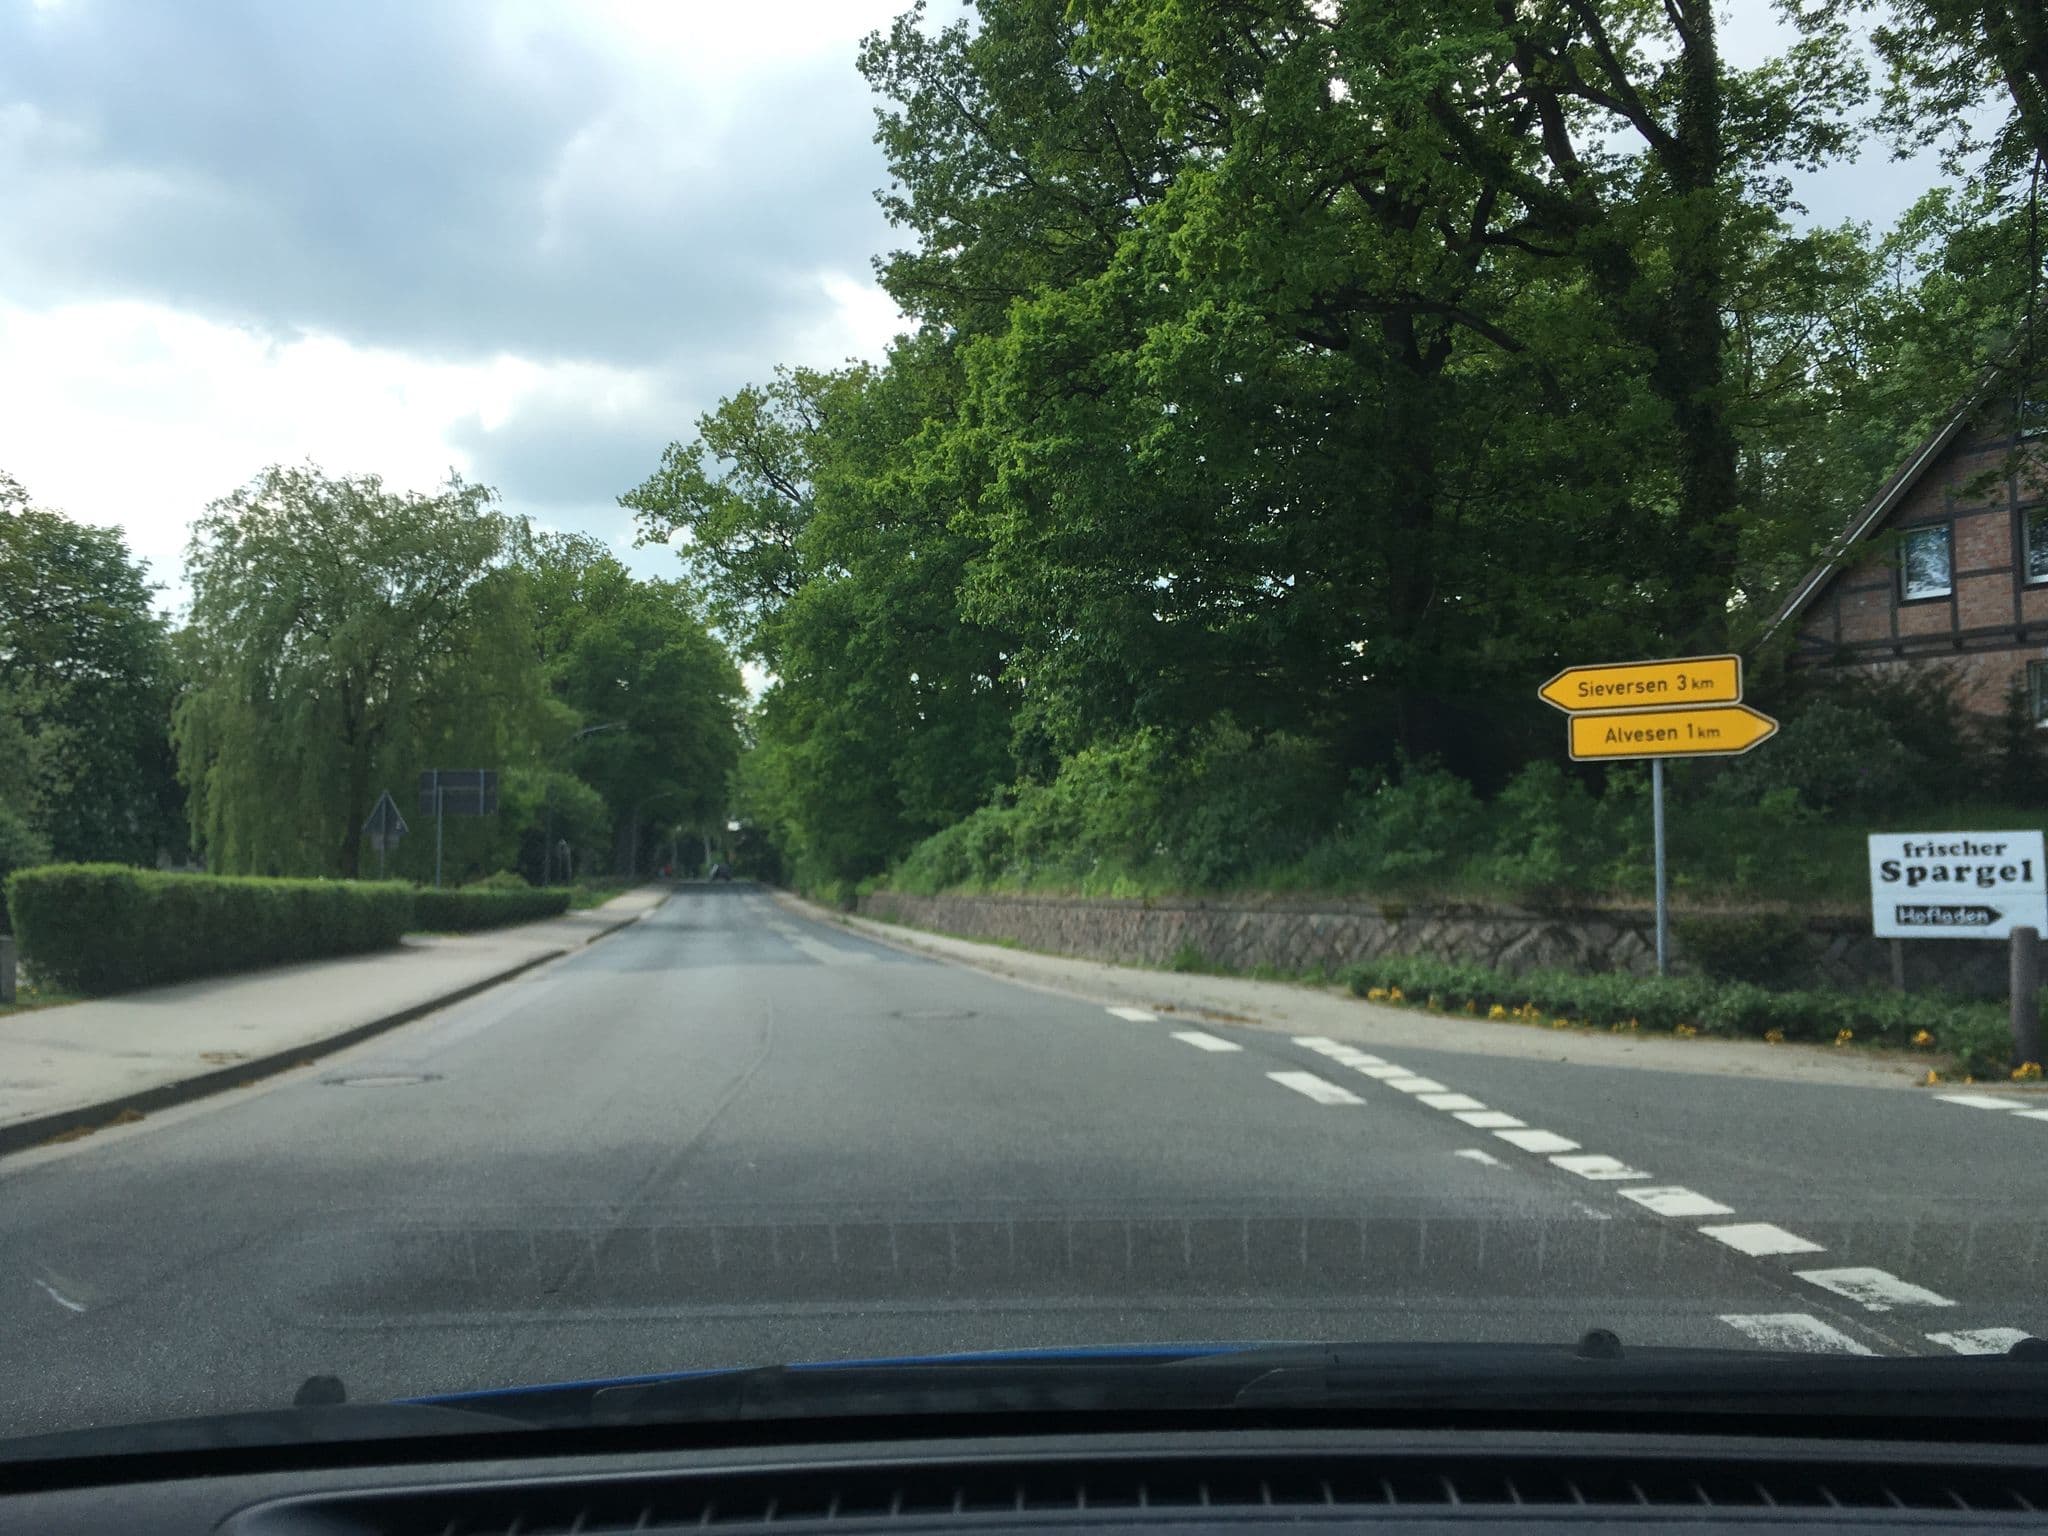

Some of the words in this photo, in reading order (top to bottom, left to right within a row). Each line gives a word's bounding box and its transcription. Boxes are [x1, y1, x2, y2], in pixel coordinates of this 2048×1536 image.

[1578, 678, 1667, 698] Sieversen
[1677, 674, 1687, 691] 3
[1691, 677, 1714, 690] km
[1605, 727, 1678, 743] Alvesen
[1686, 723, 1693, 739] 1
[1697, 726, 1720, 740] km
[1903, 840, 2008, 858] frischer
[1880, 859, 2033, 888] Spargel
